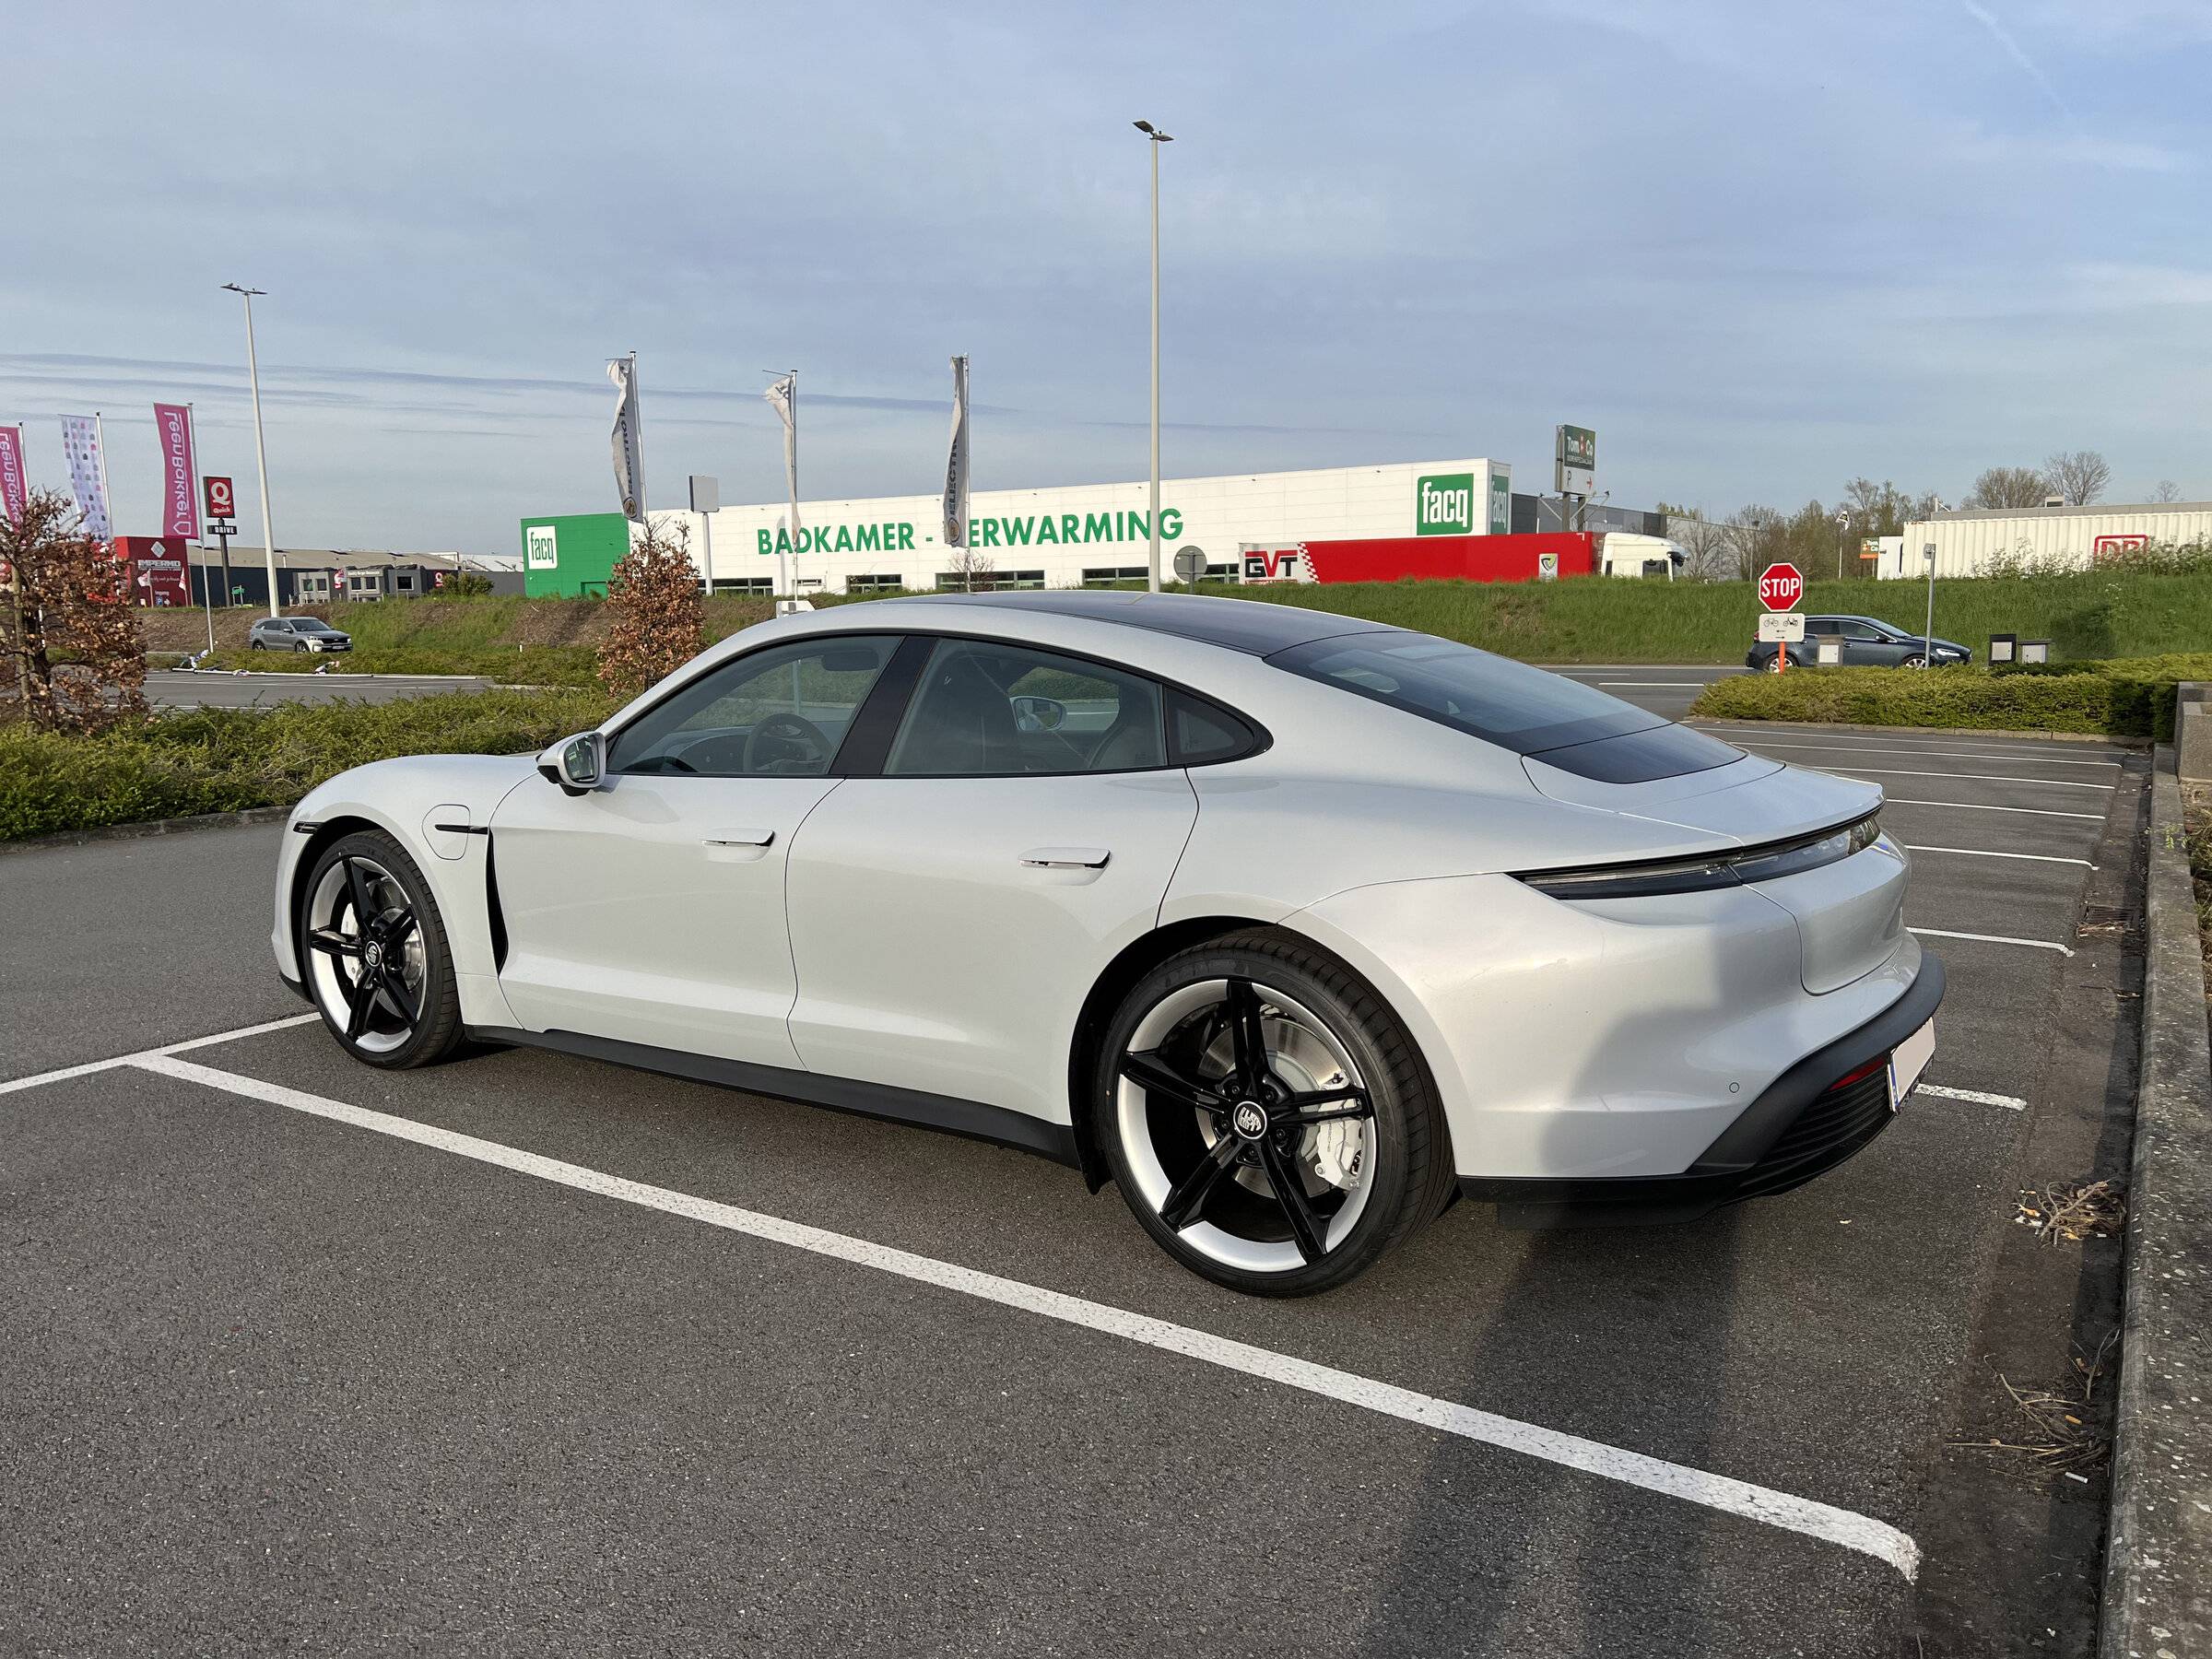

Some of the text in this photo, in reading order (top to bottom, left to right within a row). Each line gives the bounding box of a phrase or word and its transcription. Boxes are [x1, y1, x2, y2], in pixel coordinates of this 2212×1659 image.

[1421, 481, 1469, 528] facq
[530, 531, 554, 564] facq
[758, 523, 915, 555] BADKAMER
[969, 508, 1183, 547] ERWARMING
[1244, 550, 1298, 578] GVT
[1761, 578, 1800, 598] STOP
